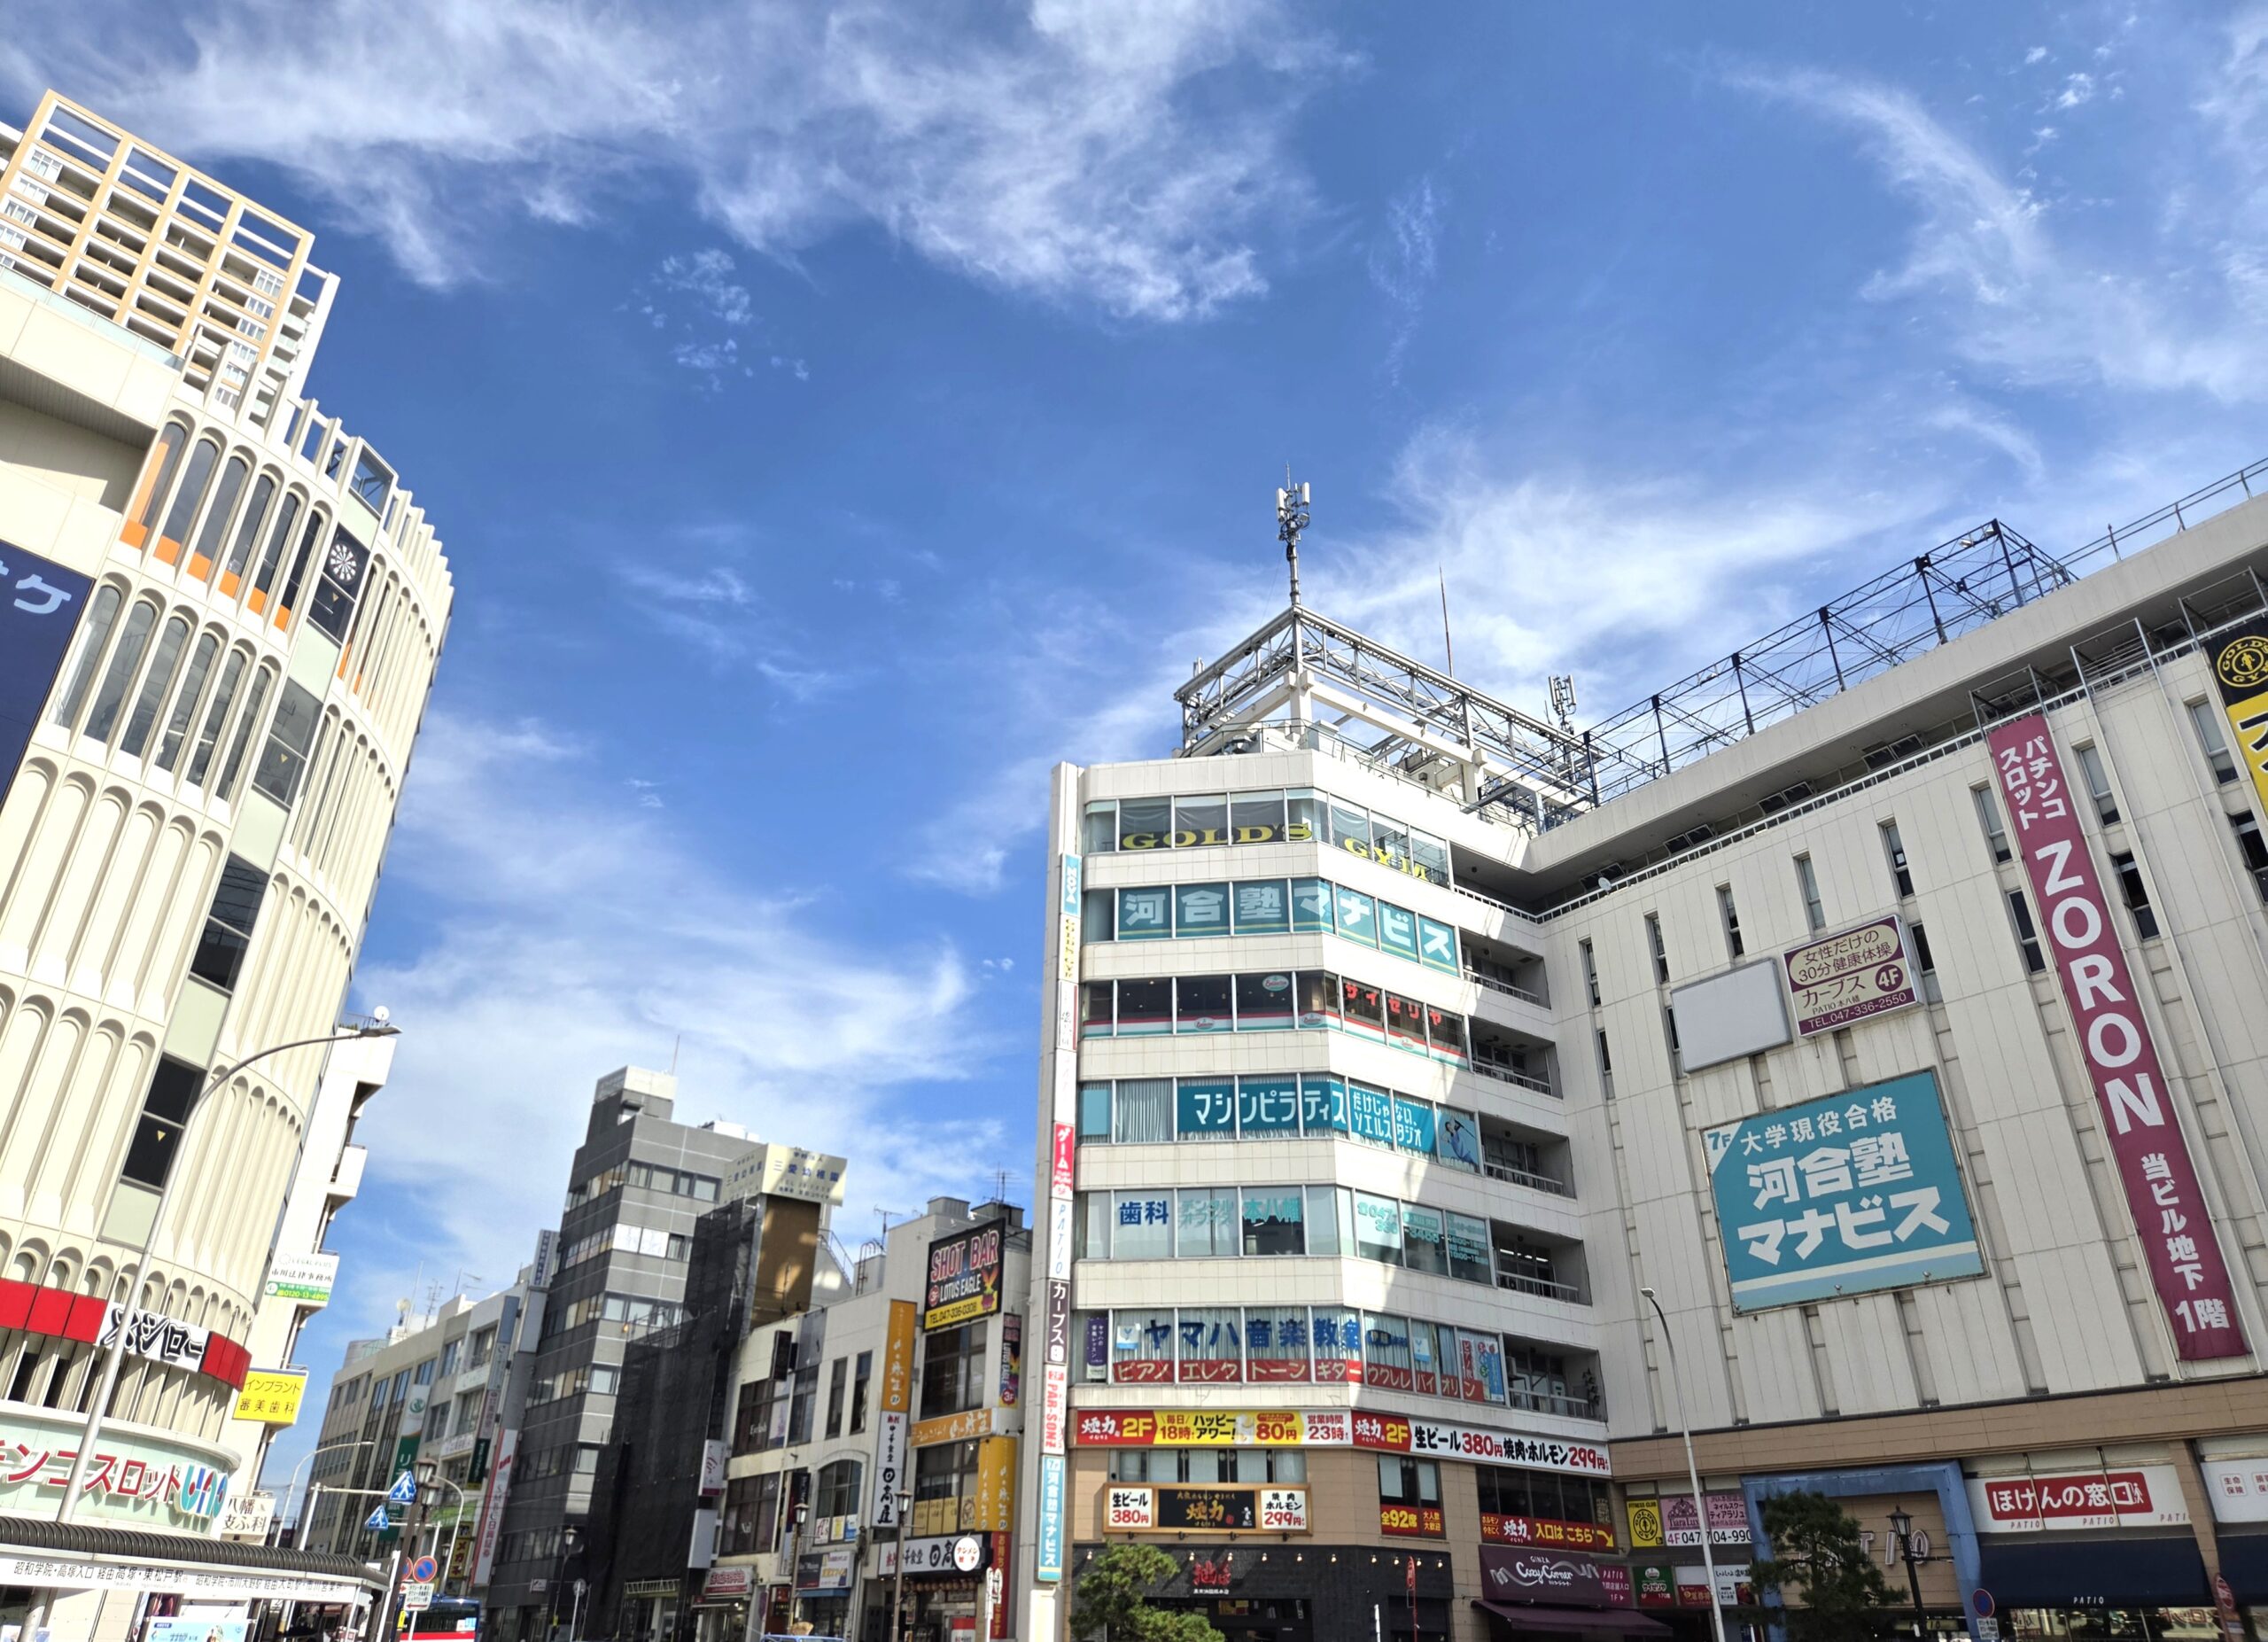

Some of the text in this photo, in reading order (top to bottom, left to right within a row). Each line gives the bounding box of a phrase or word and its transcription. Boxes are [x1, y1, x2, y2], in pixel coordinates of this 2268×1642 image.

[0, 558, 72, 614] ケ
[2000, 747, 2039, 831] スロット
[2026, 735, 2066, 820] パチンコ
[1122, 821, 1428, 882] GOLD'S GYM
[1066, 867, 1077, 904] NOVA
[1125, 887, 1453, 961] 河合塾マナビス
[1798, 942, 1892, 983] 30分健康体操
[1803, 930, 1879, 966] 女性だけの
[1802, 976, 1866, 1008] カーブス
[1878, 968, 1899, 988] 4F
[2035, 838, 2166, 1136] ZORON
[1345, 981, 1442, 1026] サイゼリヤ
[1807, 992, 1907, 1029] TEL.047-336-2550
[1812, 1003, 1837, 1015] PATIO
[1193, 1089, 1347, 1125] マシンピラティス
[1739, 1095, 1899, 1156] 大学現役合格
[1057, 1126, 1072, 1170] ゲーム
[1707, 1132, 1733, 1153] 7F
[1745, 1132, 1915, 1210] 河合塾
[1119, 1200, 1169, 1226] 歯科
[1243, 1196, 1302, 1224] 本八幡
[1055, 1203, 1067, 1275] PATIO
[1737, 1186, 1952, 1266] マナビス
[931, 1229, 999, 1282] SHOT BAR
[2140, 1153, 2232, 1335] 当ビル地下1階
[940, 1280, 960, 1303] LOTUS
[960, 1273, 982, 1296] EAGLE
[1050, 1283, 1067, 1344] カーブス
[101, 1306, 206, 1359] スシロー
[246, 1379, 300, 1394] インプラント
[1116, 1361, 1475, 1397] ピアノ エレクトーン ギター ウクレレ バイオリン
[239, 1398, 295, 1415] 審美歯科
[1167, 1415, 1184, 1424] 毎日
[1193, 1415, 1236, 1427] ハッピー
[1308, 1415, 1344, 1424] 営業時間
[1082, 1415, 1153, 1437] 煙力 2F
[1161, 1426, 1192, 1441] 18時
[1256, 1423, 1297, 1441] 80円
[1309, 1426, 1345, 1441] 23時
[1355, 1418, 1381, 1437] 煙力
[1386, 1423, 1409, 1444] 2F
[1415, 1426, 1461, 1450] 生ビール
[1462, 1432, 1503, 1458] 380円
[1569, 1445, 1607, 1472] 299円
[0, 1439, 181, 1503] ンコスロット
[2223, 1475, 2241, 1486] 生命
[1112, 1491, 1148, 1507] 生ビール
[1992, 1481, 2133, 1514] ほけんの窓口
[2225, 1485, 2244, 1495] 保険
[1111, 1509, 1149, 1523] 380円
[1185, 1500, 1224, 1521] 煙力
[1264, 1512, 1302, 1526] 299円
[1380, 1508, 1418, 1529] 全92席
[2010, 1520, 2040, 1529] PATIO
[2083, 1516, 2115, 1526] PATIO
[1503, 1518, 1528, 1537] 煙力
[1667, 1532, 1680, 1545] 4F
[1603, 1569, 1624, 1579] PATIO
[2073, 1595, 2105, 1605] PATIO
